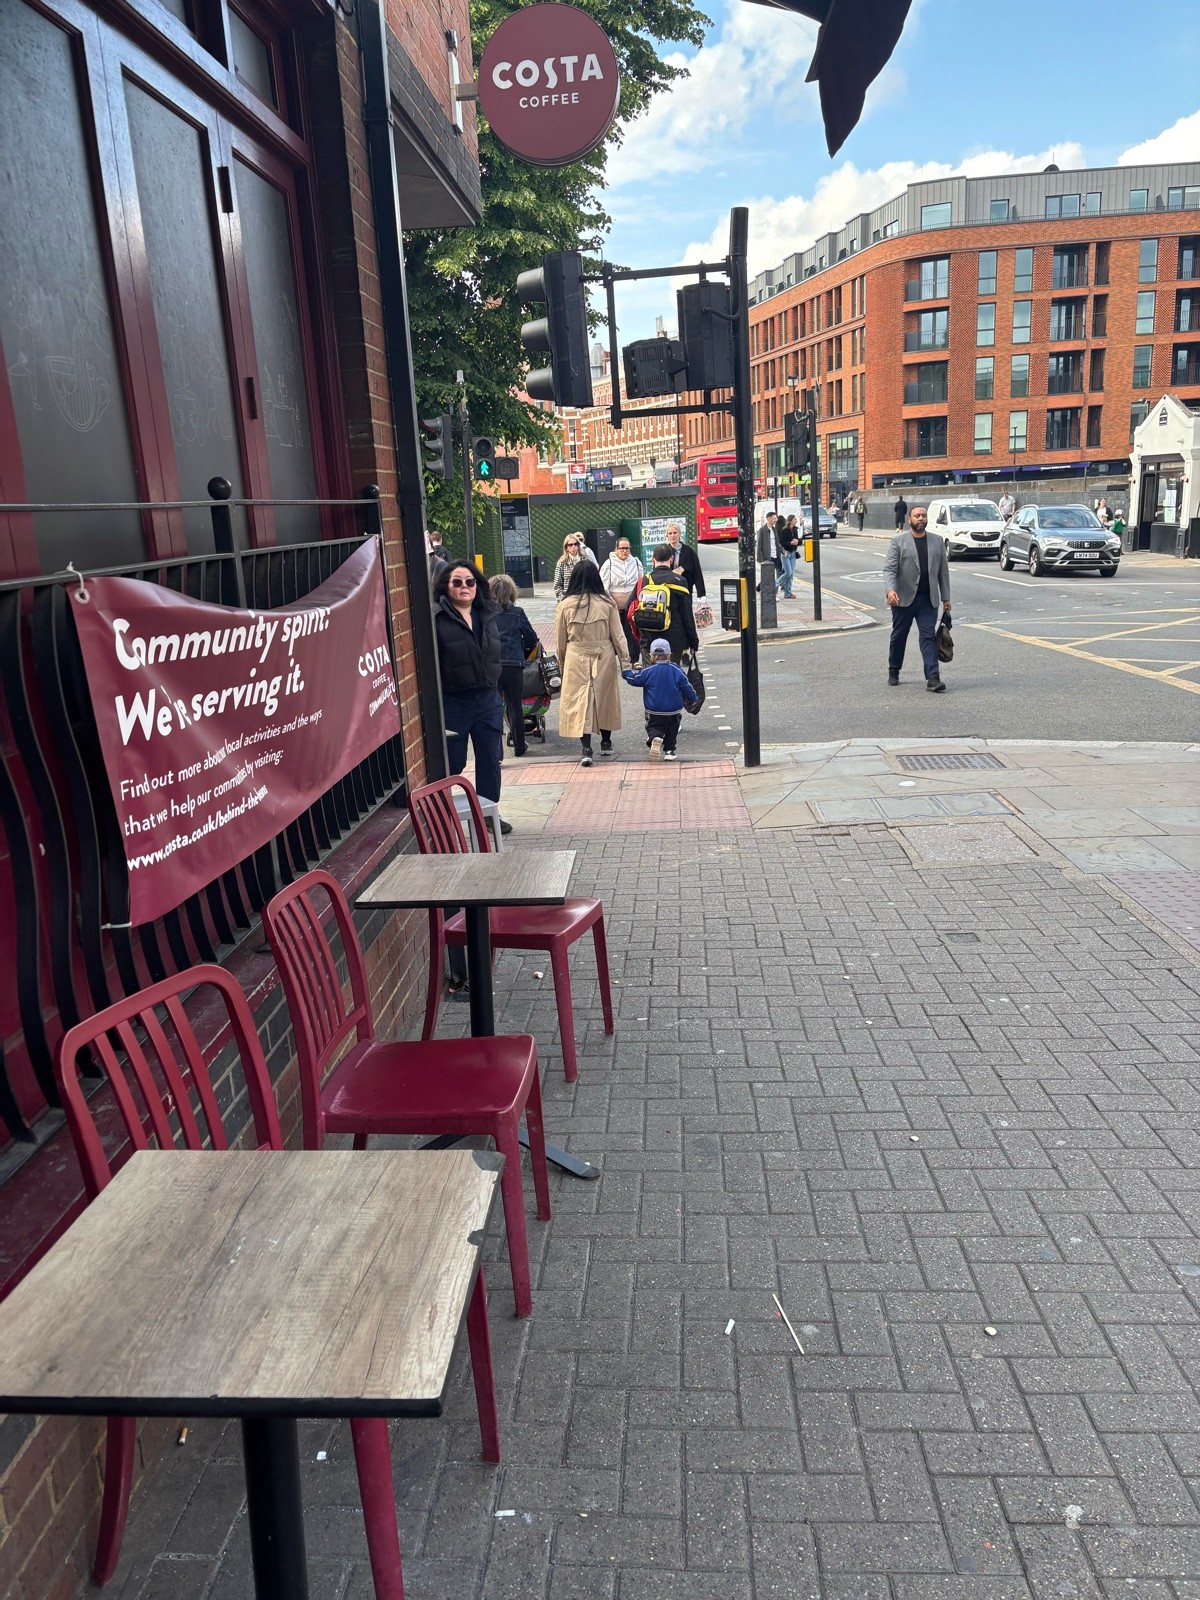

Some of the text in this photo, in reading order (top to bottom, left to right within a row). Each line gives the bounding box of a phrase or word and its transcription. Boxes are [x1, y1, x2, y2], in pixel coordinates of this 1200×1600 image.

[492, 53, 604, 90] COSTA
[519, 92, 580, 109] COFFEE
[113, 606, 331, 670] Community spirit:
[358, 644, 391, 677] COSTA
[191, 667, 282, 721] serving
[285, 657, 305, 696] it.
[372, 673, 387, 689] COFFEE
[120, 773, 150, 801] Find
[151, 770, 174, 790] out
[178, 762, 202, 782] more
[224, 732, 243, 755] local
[244, 723, 281, 747] activities
[282, 716, 298, 734] and
[297, 713, 309, 729] the
[309, 709, 323, 724] ways
[125, 815, 156, 836] that
[156, 808, 168, 825] we
[171, 794, 196, 819] help
[197, 789, 212, 806] our
[244, 759, 254, 779] by
[254, 748, 284, 769] visiting:
